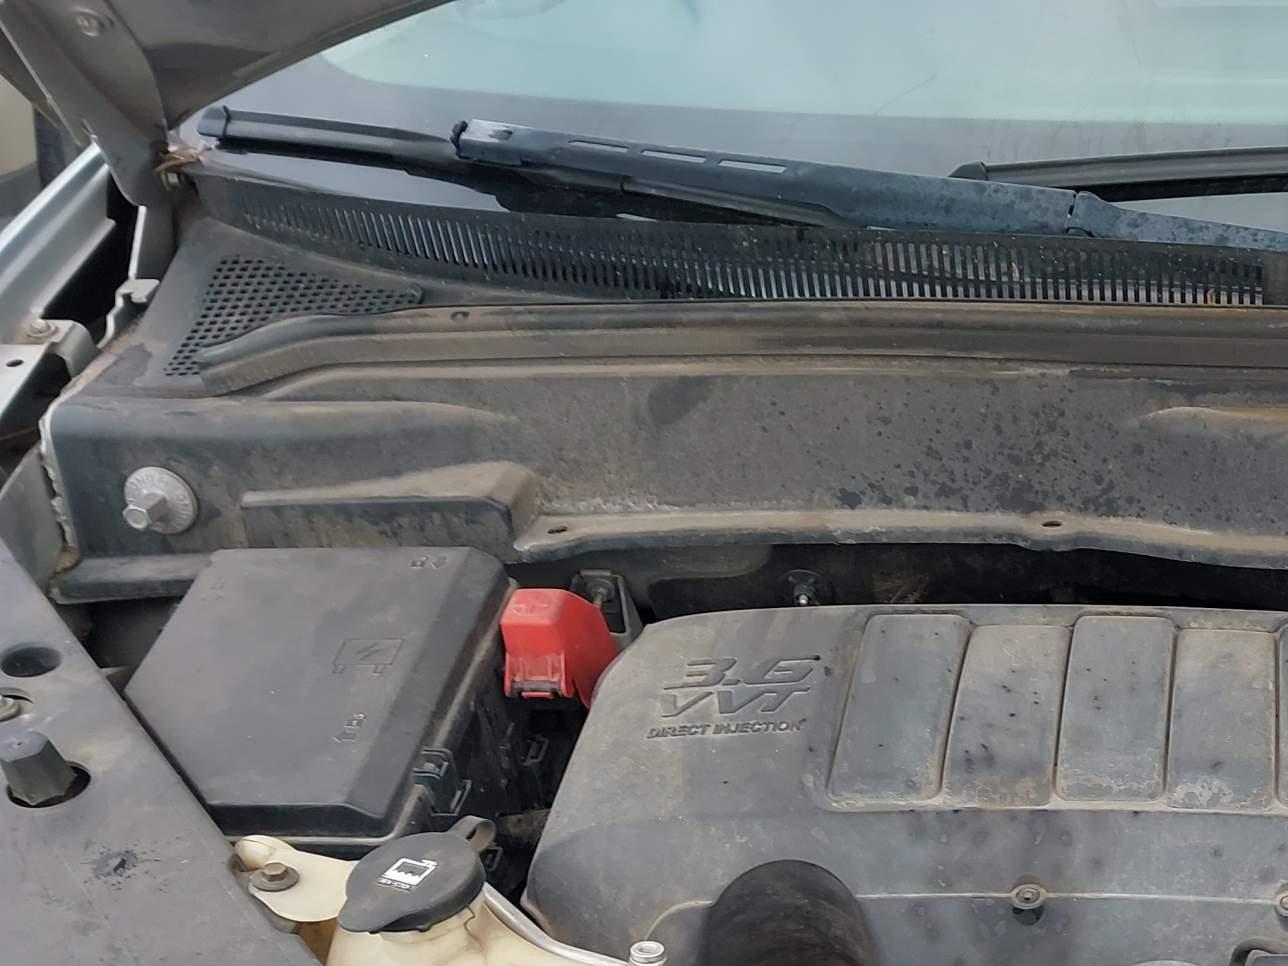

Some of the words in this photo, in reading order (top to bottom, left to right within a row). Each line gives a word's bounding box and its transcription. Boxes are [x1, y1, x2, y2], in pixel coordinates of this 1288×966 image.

[663, 655, 821, 690] 3.6
[659, 687, 810, 717] VVT
[646, 723, 711, 739] DIRECT
[712, 719, 803, 735] INJECTION
